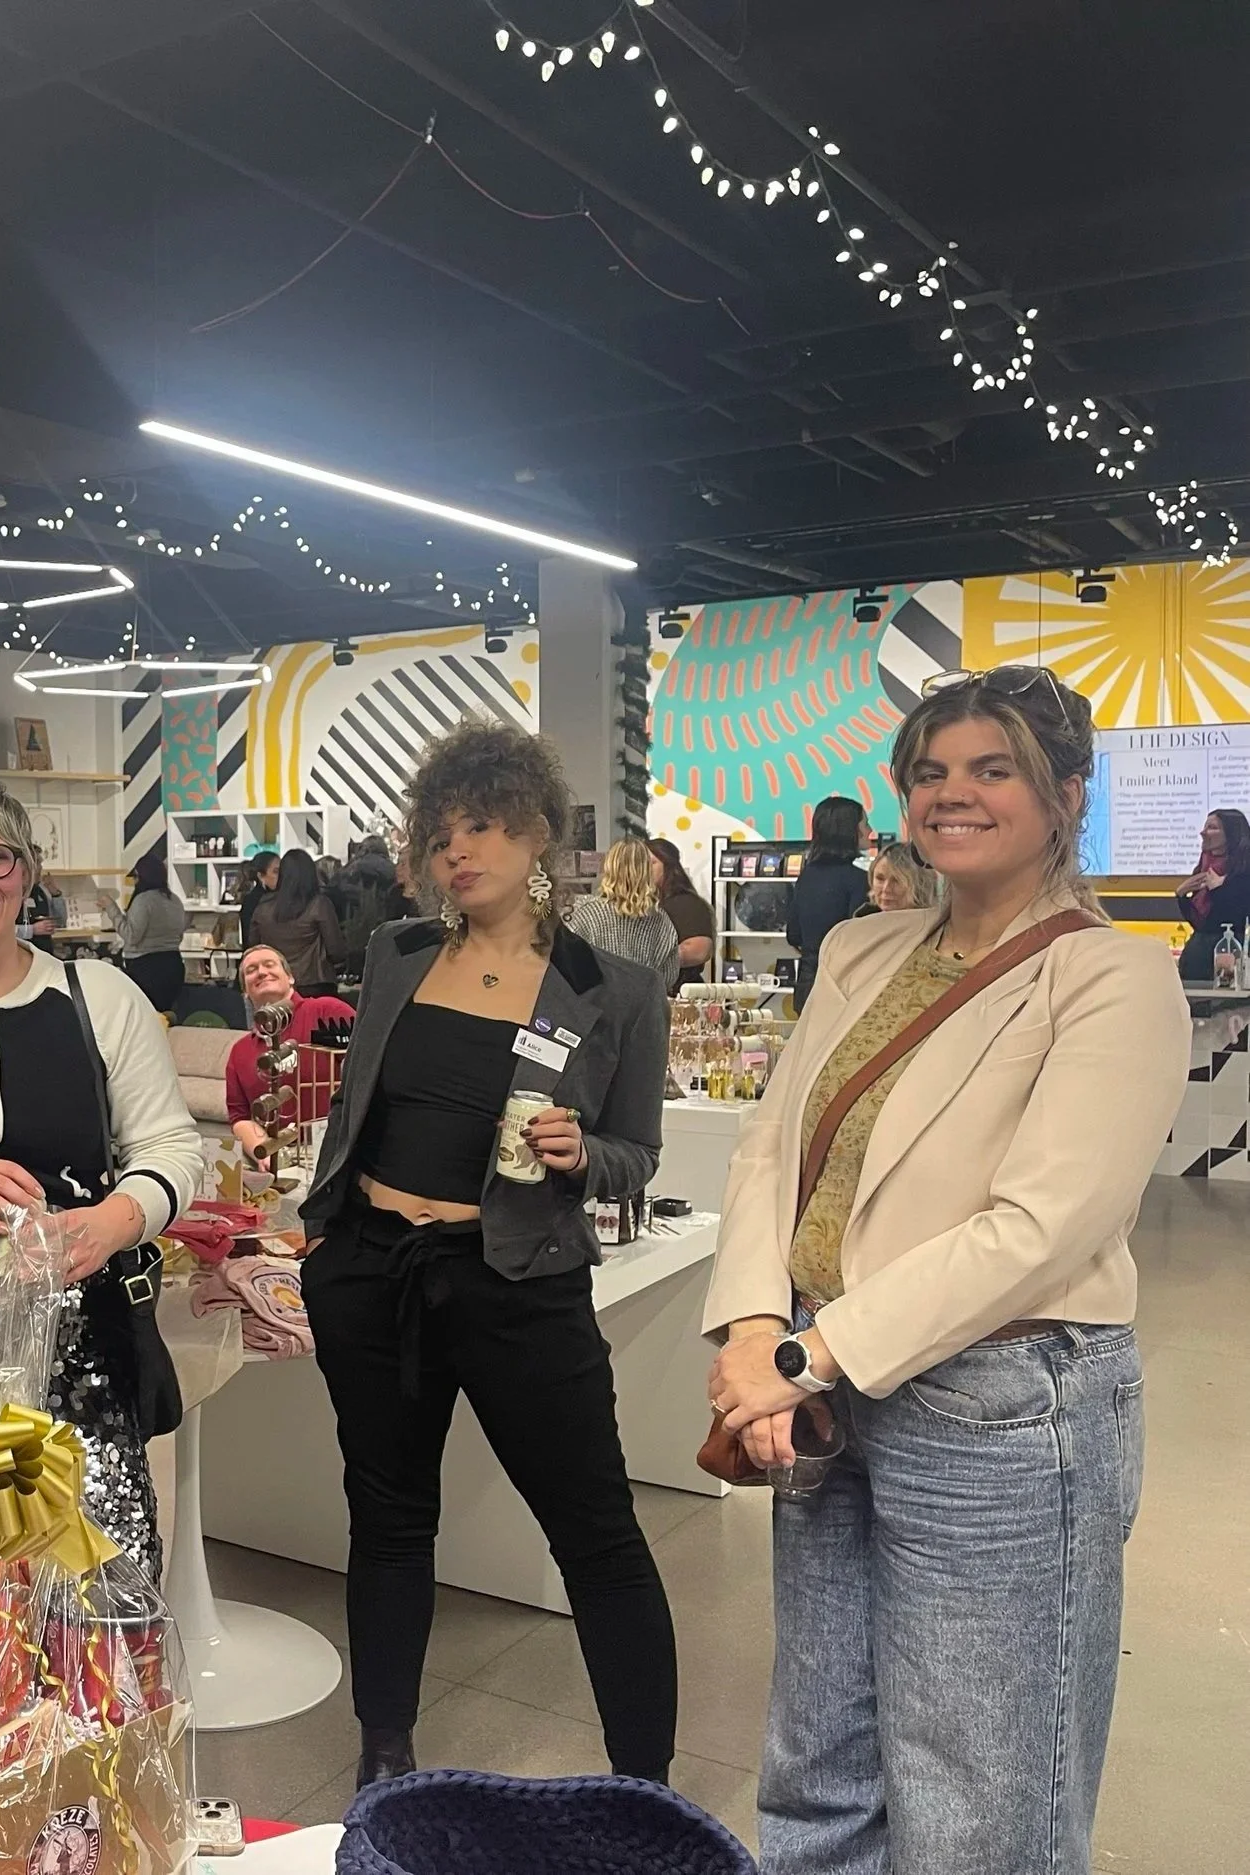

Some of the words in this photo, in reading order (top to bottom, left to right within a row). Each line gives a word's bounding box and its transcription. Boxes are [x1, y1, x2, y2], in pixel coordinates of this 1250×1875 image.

[1130, 733, 1166, 749] LEIF
[1170, 731, 1231, 747] DESIGN
[1143, 757, 1171, 767] Meet
[1119, 775, 1155, 787] Emilie
